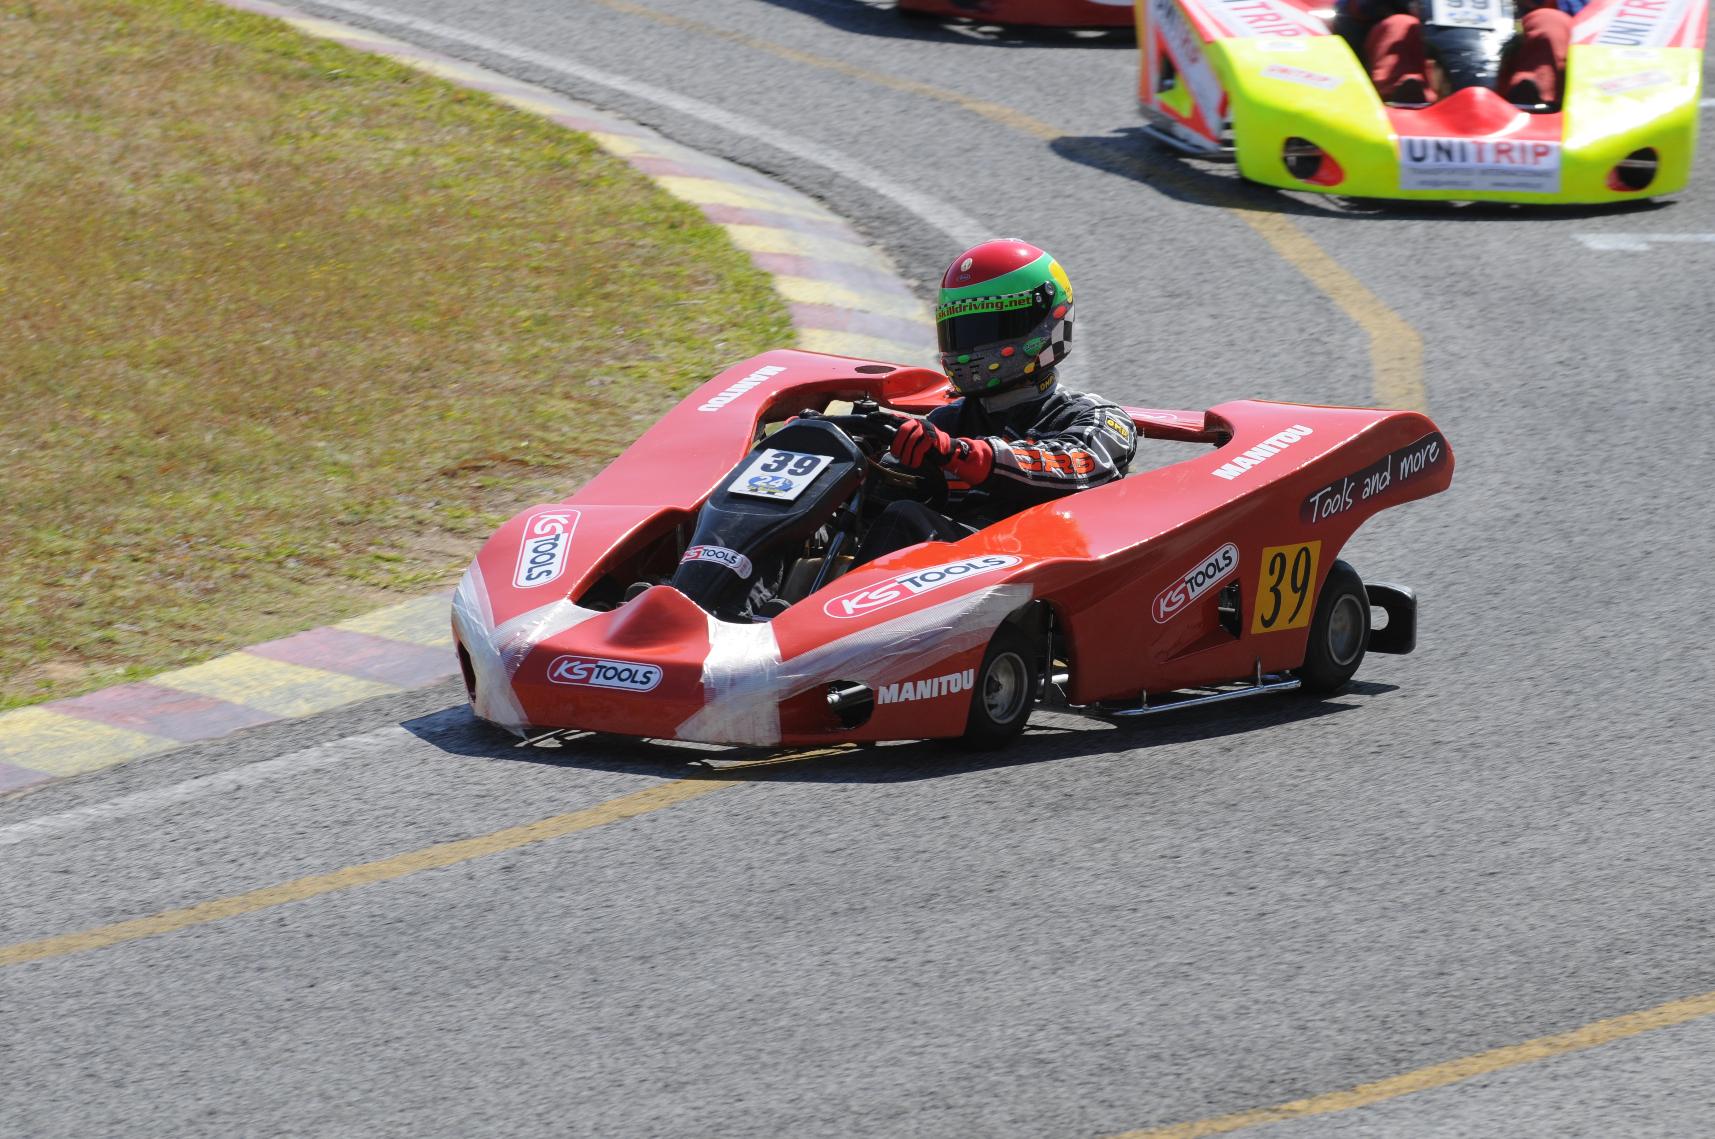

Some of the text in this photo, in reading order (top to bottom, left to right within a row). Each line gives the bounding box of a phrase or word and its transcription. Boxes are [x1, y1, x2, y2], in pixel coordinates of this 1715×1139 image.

[1406, 138, 1551, 165] UNITRIP
[760, 452, 821, 476] 39
[1211, 424, 1314, 481] MANITOU
[1310, 440, 1440, 523] Tools and more
[1260, 546, 1312, 628] 39
[877, 669, 975, 704] MANITOU
